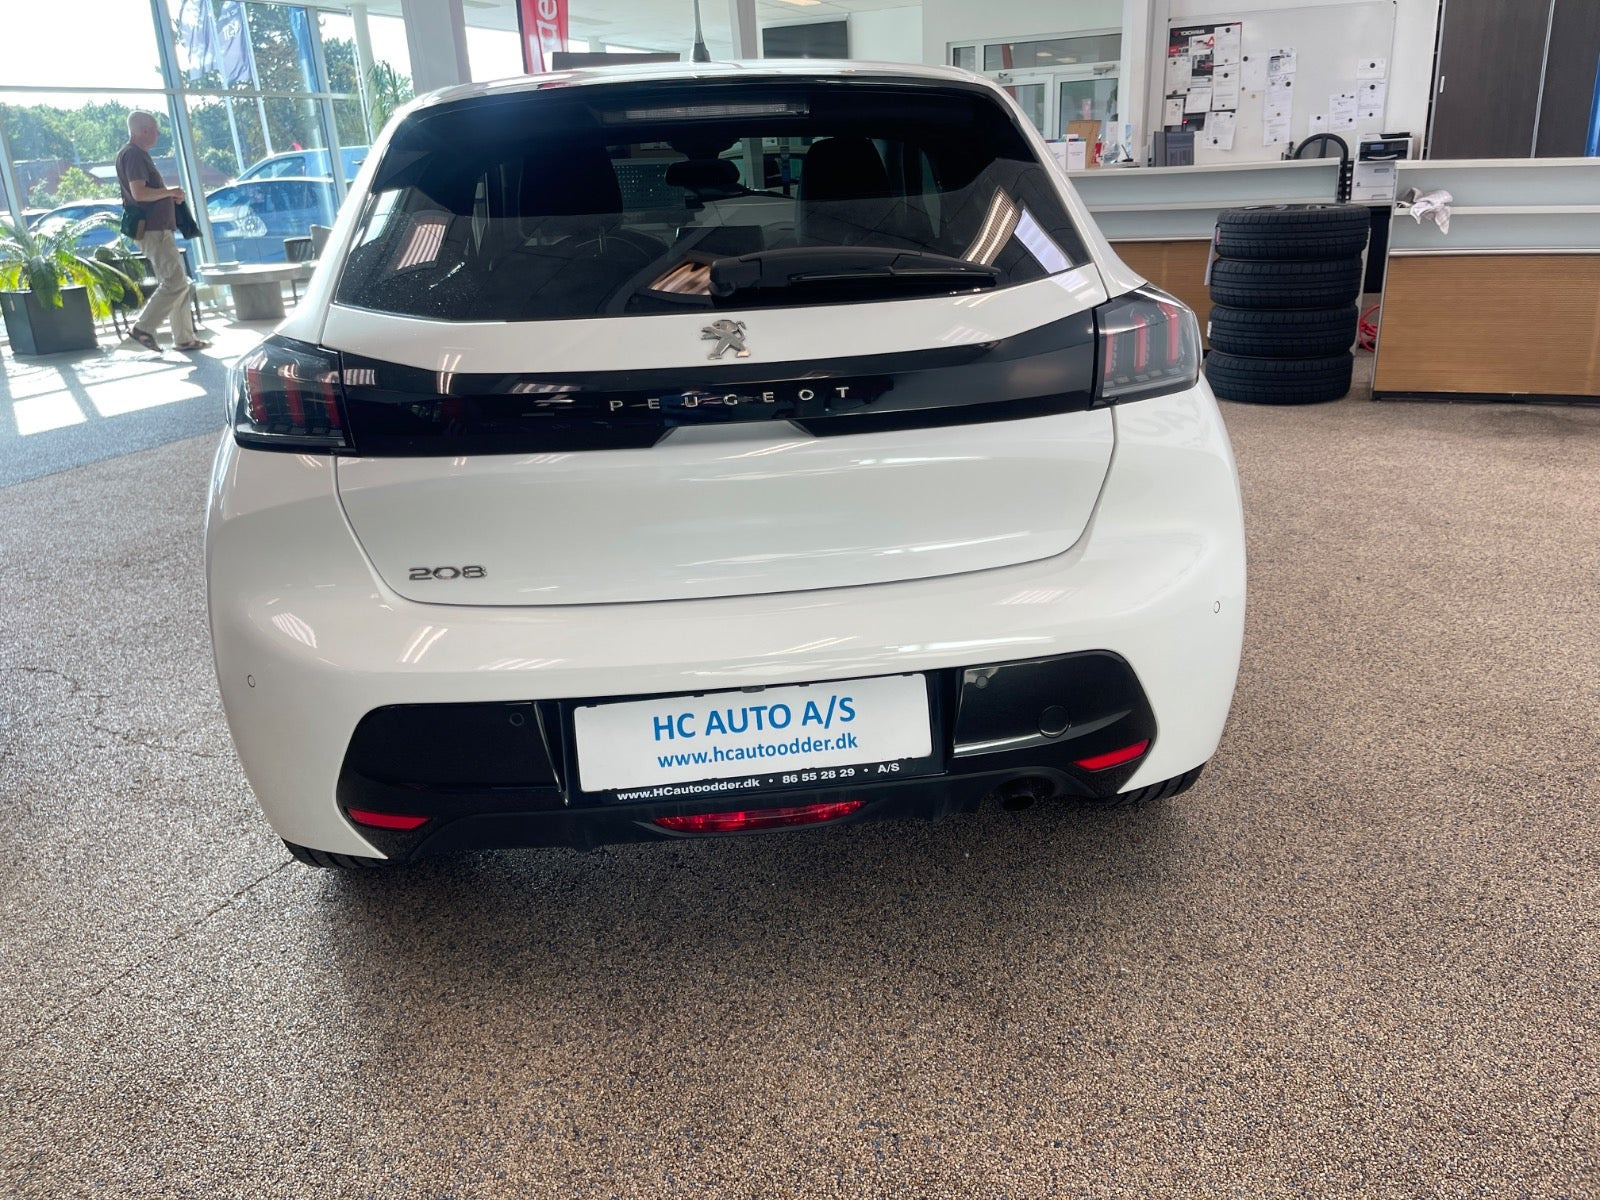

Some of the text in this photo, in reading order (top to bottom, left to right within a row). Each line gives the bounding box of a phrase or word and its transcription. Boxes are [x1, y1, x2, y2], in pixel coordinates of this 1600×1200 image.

[609, 386, 850, 412] PEUGEOT
[408, 565, 487, 580] 208
[653, 695, 856, 741] HC AUTO A/S
[657, 732, 858, 768] www.hcautoodder.dk
[616, 762, 900, 801] www.HCautoodder.dk 86 55 28 29 A/S
